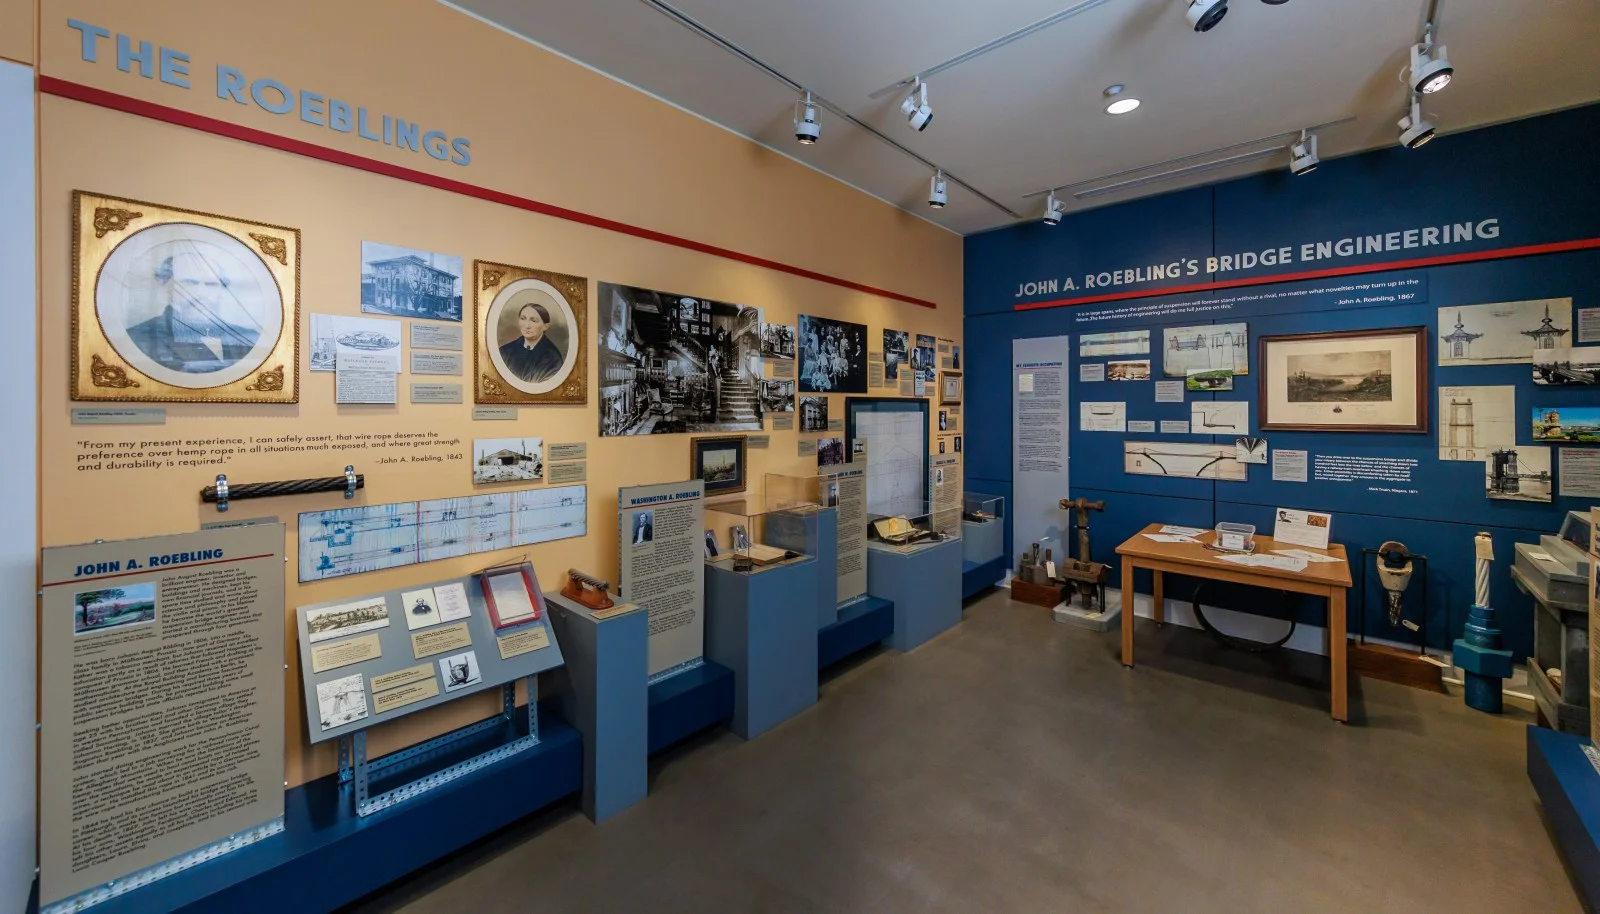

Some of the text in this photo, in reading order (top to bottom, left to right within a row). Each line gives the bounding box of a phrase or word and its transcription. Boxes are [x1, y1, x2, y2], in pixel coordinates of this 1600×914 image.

[67, 18, 472, 167] THE ROEBLINGS
[1014, 218, 1500, 298] JOHN A. ROEBLING'S BRIDGE ENGINEERING
[1364, 294, 1396, 304] Roebling,
[1138, 304, 1157, 312] principle
[1164, 301, 1191, 310] suspension
[1133, 310, 1160, 319] engineering
[119, 442, 136, 450] my
[140, 439, 182, 449] present
[186, 437, 246, 448] experience,
[276, 435, 303, 445] safely
[306, 434, 334, 444] assert,
[374, 433, 392, 442] rope
[78, 450, 144, 461] preference
[177, 447, 207, 458] hemp
[210, 448, 234, 457] rope
[264, 444, 304, 452] situations
[332, 441, 369, 452] exposed,
[414, 438, 432, 448] great
[434, 437, 460, 447] strength
[107, 459, 162, 471] durability
[179, 456, 232, 467] required."
[412, 454, 444, 463] Roebling,
[630, 494, 667, 505] WASHINGTON
[676, 490, 700, 500] ROEBLING
[74, 548, 224, 577] JOHN A. ROEBLING
[199, 570, 222, 578] Roebling
[186, 576, 210, 585] engineer,
[212, 578, 235, 586] designed
[162, 590, 187, 599] buildings
[197, 599, 226, 609] philosophy
[227, 605, 248, 613] greatest
[162, 620, 193, 630] suspension
[195, 616, 212, 624] bridge
[214, 612, 237, 620] engineer
[190, 618, 228, 630] manufacturing
[162, 630, 191, 641] prospered
[193, 626, 214, 635] through
